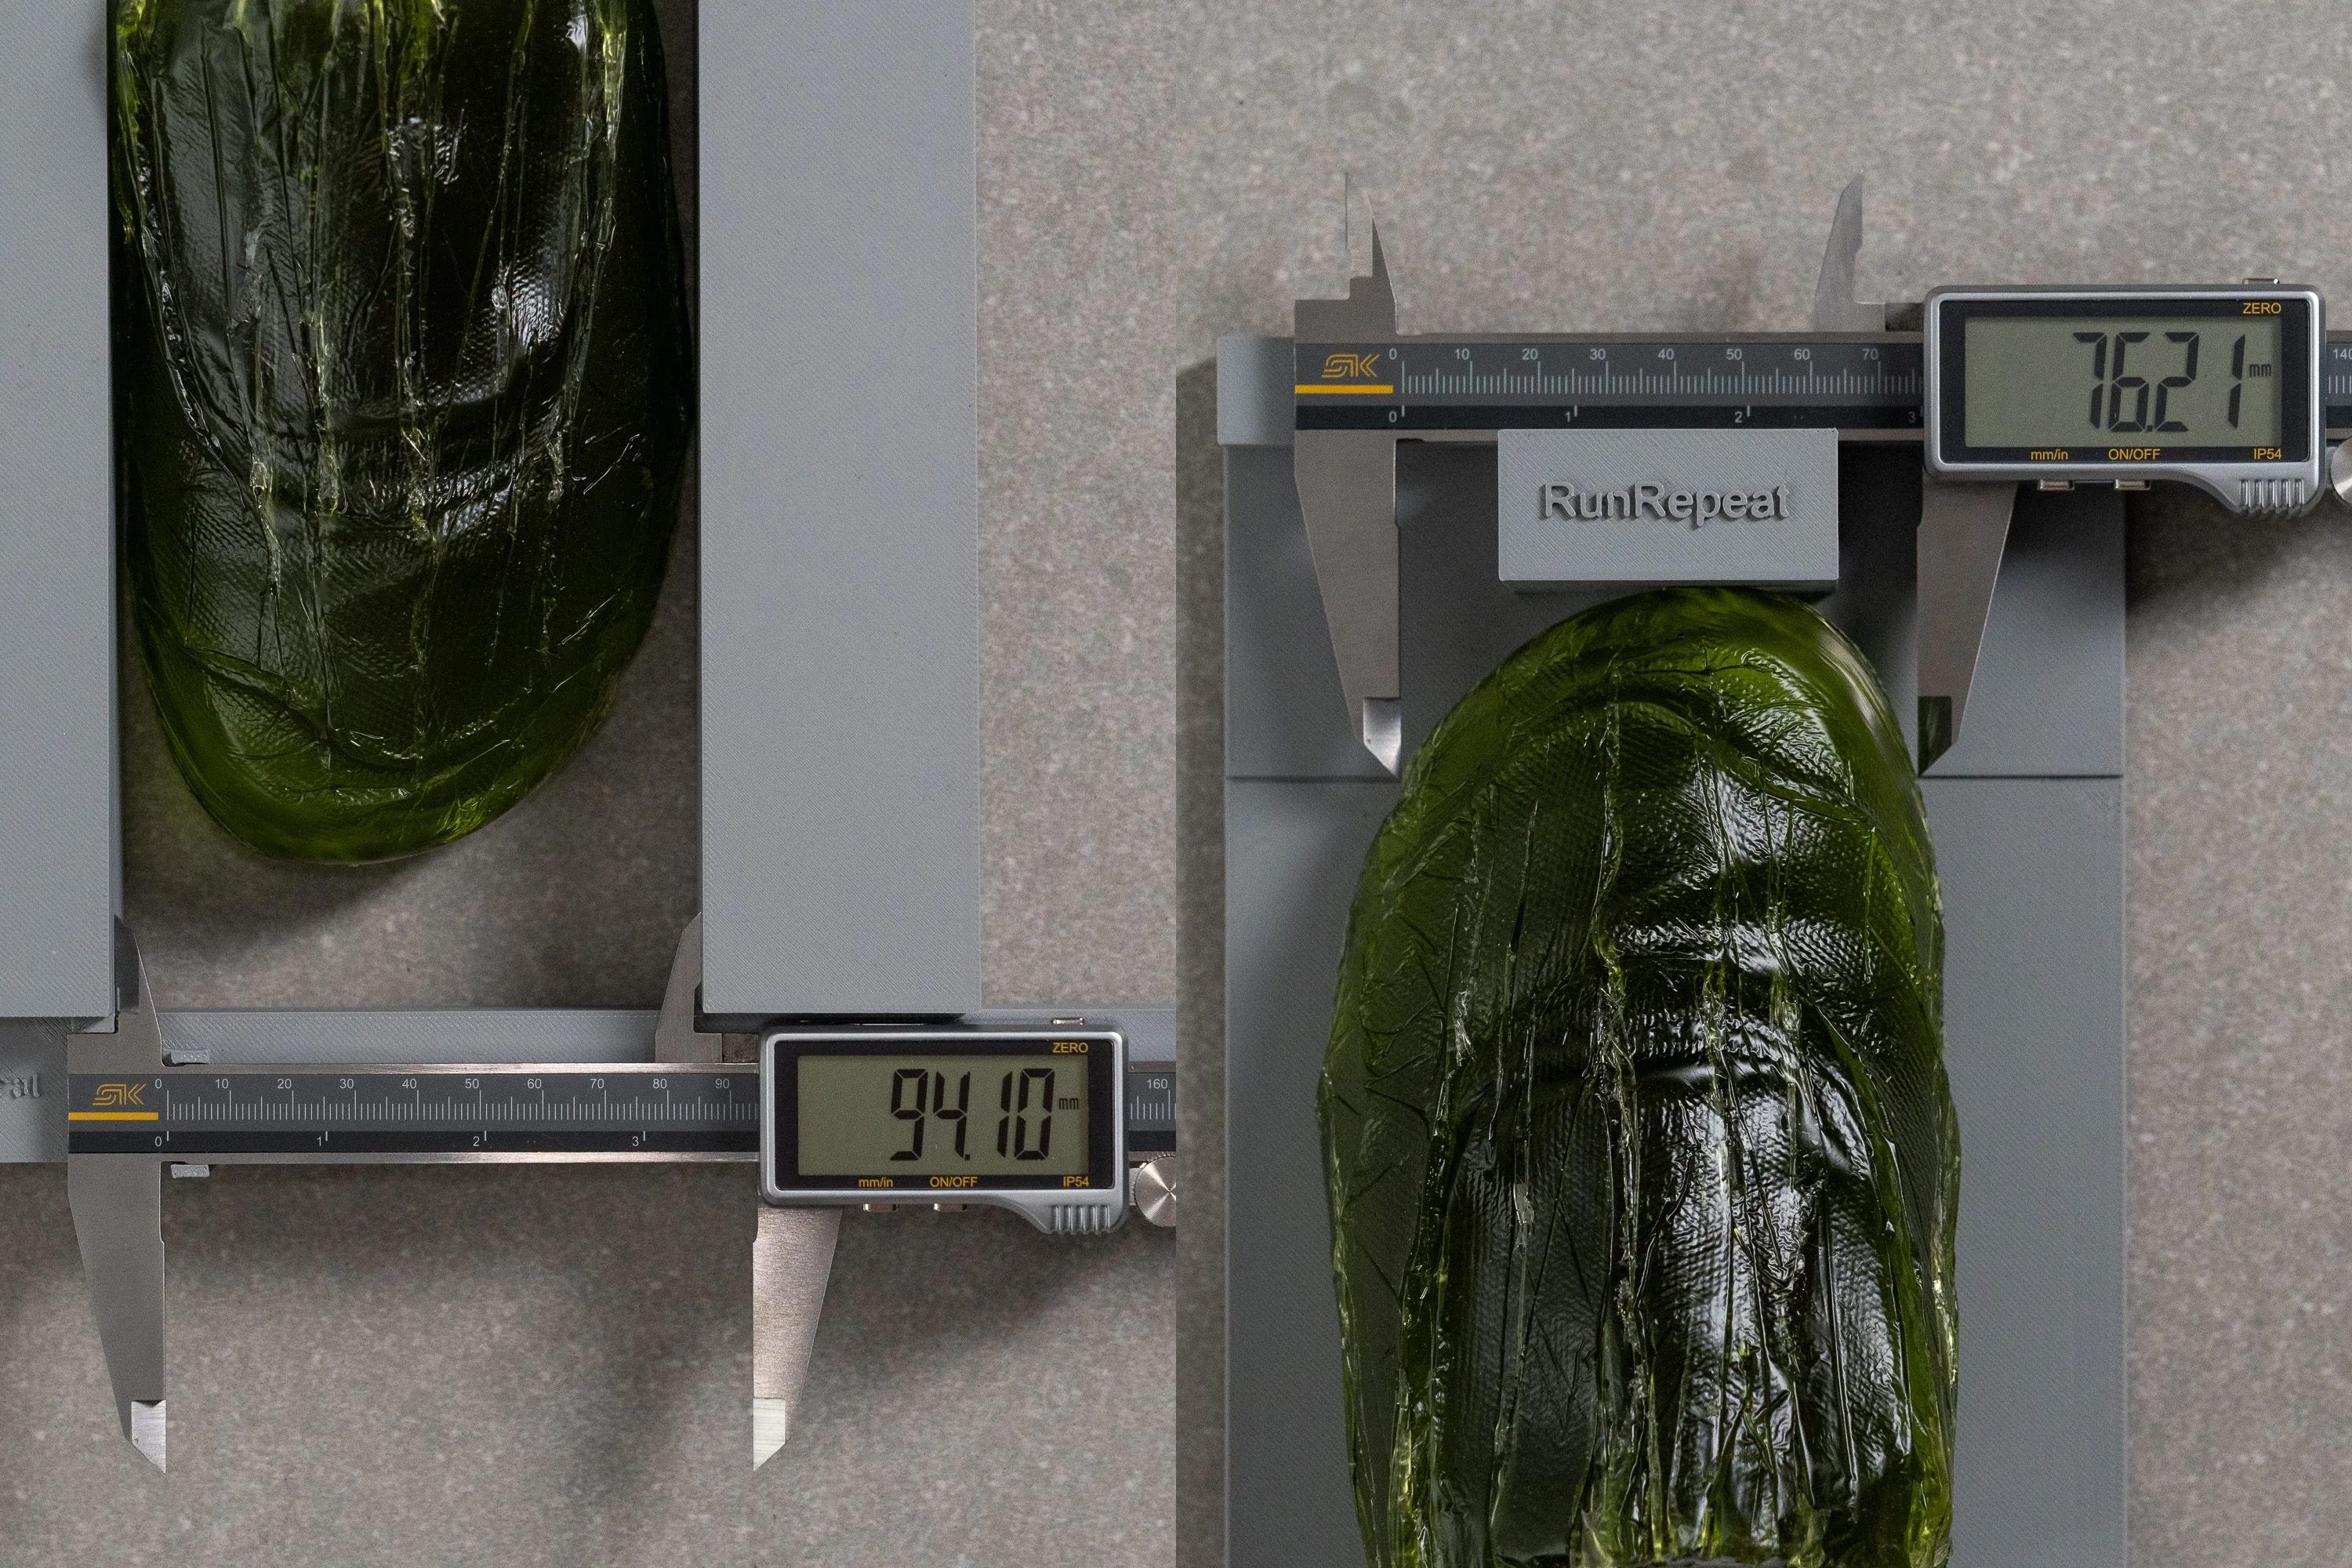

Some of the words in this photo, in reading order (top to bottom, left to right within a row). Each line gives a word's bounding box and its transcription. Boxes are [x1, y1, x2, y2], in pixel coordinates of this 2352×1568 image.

[2242, 303, 2281, 314] ZERO
[1388, 348, 1397, 360] 0
[1455, 349, 1470, 361] 10
[1522, 348, 1539, 361] 20
[1589, 348, 1606, 361] 30
[1657, 349, 1675, 361] 40
[1726, 349, 1743, 361] 50
[1794, 348, 1811, 360] 60
[1862, 348, 1878, 360] 70
[2072, 332, 2246, 433] 76.21
[2249, 362, 2272, 377] mm
[1388, 411, 1397, 423] 0
[1566, 412, 1570, 423] 1
[1734, 411, 1743, 423] 2
[1907, 411, 1915, 423] 3
[2031, 448, 2068, 461] mm/in
[2108, 448, 2161, 461] ON/OFF
[2253, 448, 2282, 460] IP54
[1540, 481, 1791, 529] RunRepeat
[1053, 1042, 1089, 1054] ZERO
[155, 1079, 162, 1089] 0
[216, 1079, 229, 1089] 10
[278, 1079, 292, 1089] 20
[340, 1079, 354, 1089] 30
[402, 1079, 417, 1089] 40
[465, 1079, 480, 1089] 50
[527, 1079, 542, 1089] 60
[590, 1079, 604, 1089] 70
[653, 1079, 668, 1089] 80
[715, 1079, 730, 1089] 90
[1146, 1079, 1168, 1089] 160
[889, 1069, 1055, 1161] 94.10
[1058, 1097, 1080, 1110] mm
[154, 1136, 162, 1147] 0
[317, 1136, 322, 1147] 1
[473, 1136, 480, 1147] 2
[632, 1136, 639, 1147] 3
[858, 1176, 894, 1187] mm/in
[930, 1175, 978, 1188] ON/OFF
[1063, 1175, 1090, 1187] IP54
